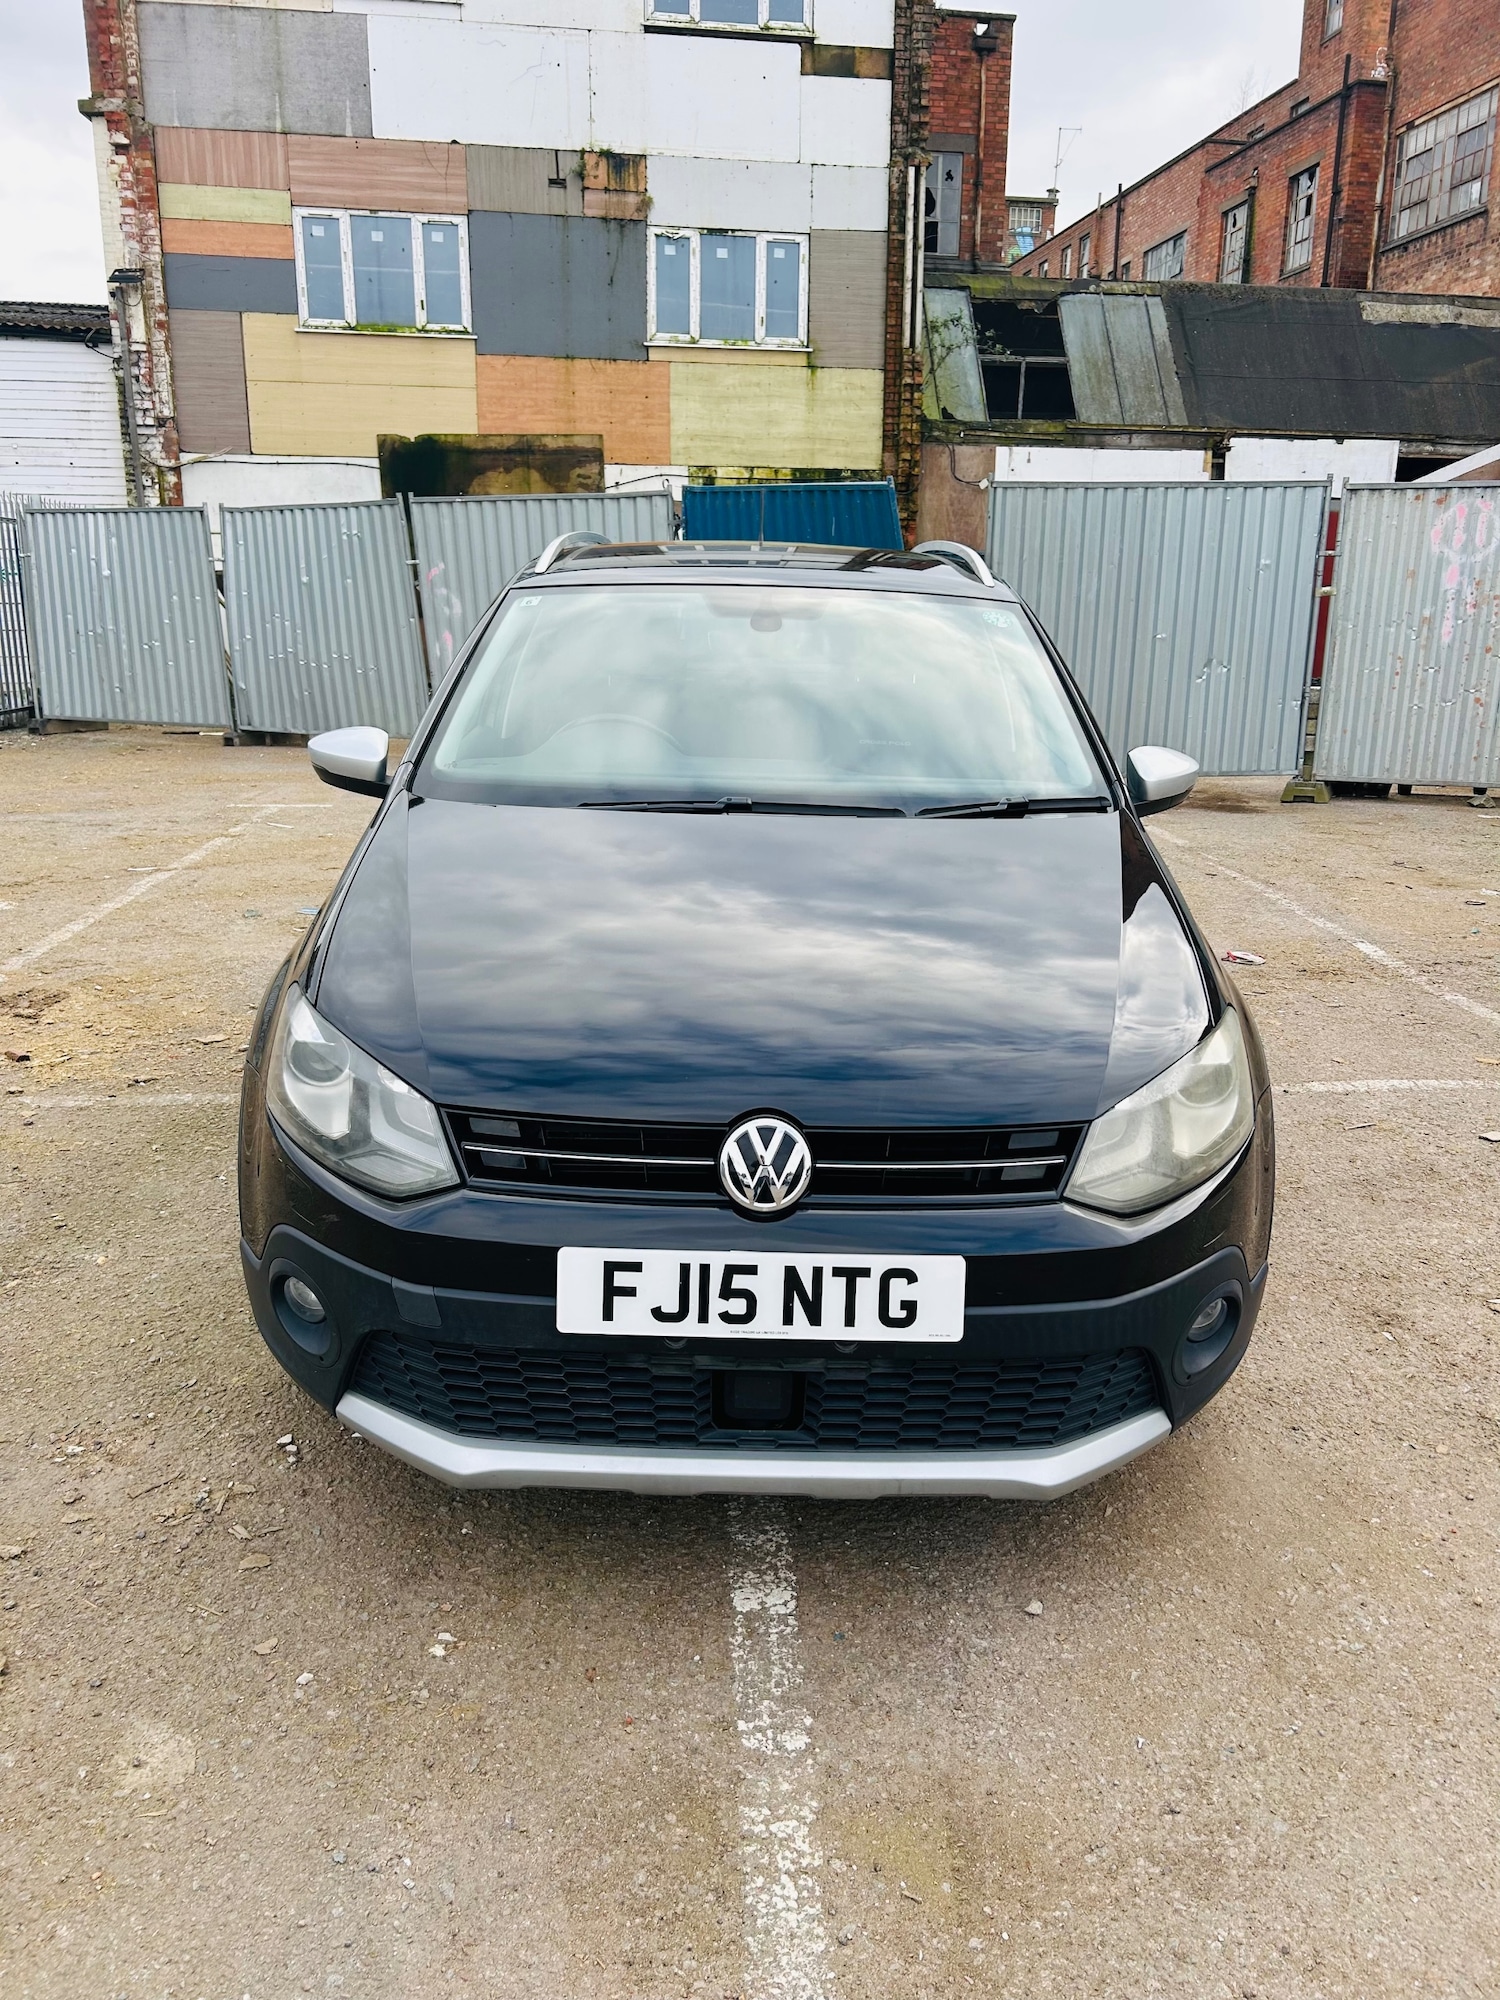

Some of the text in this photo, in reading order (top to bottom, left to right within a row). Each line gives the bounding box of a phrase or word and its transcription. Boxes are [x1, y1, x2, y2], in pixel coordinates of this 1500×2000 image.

[721, 1119, 811, 1211] VW
[603, 1260, 919, 1329] FJ15 NTG
